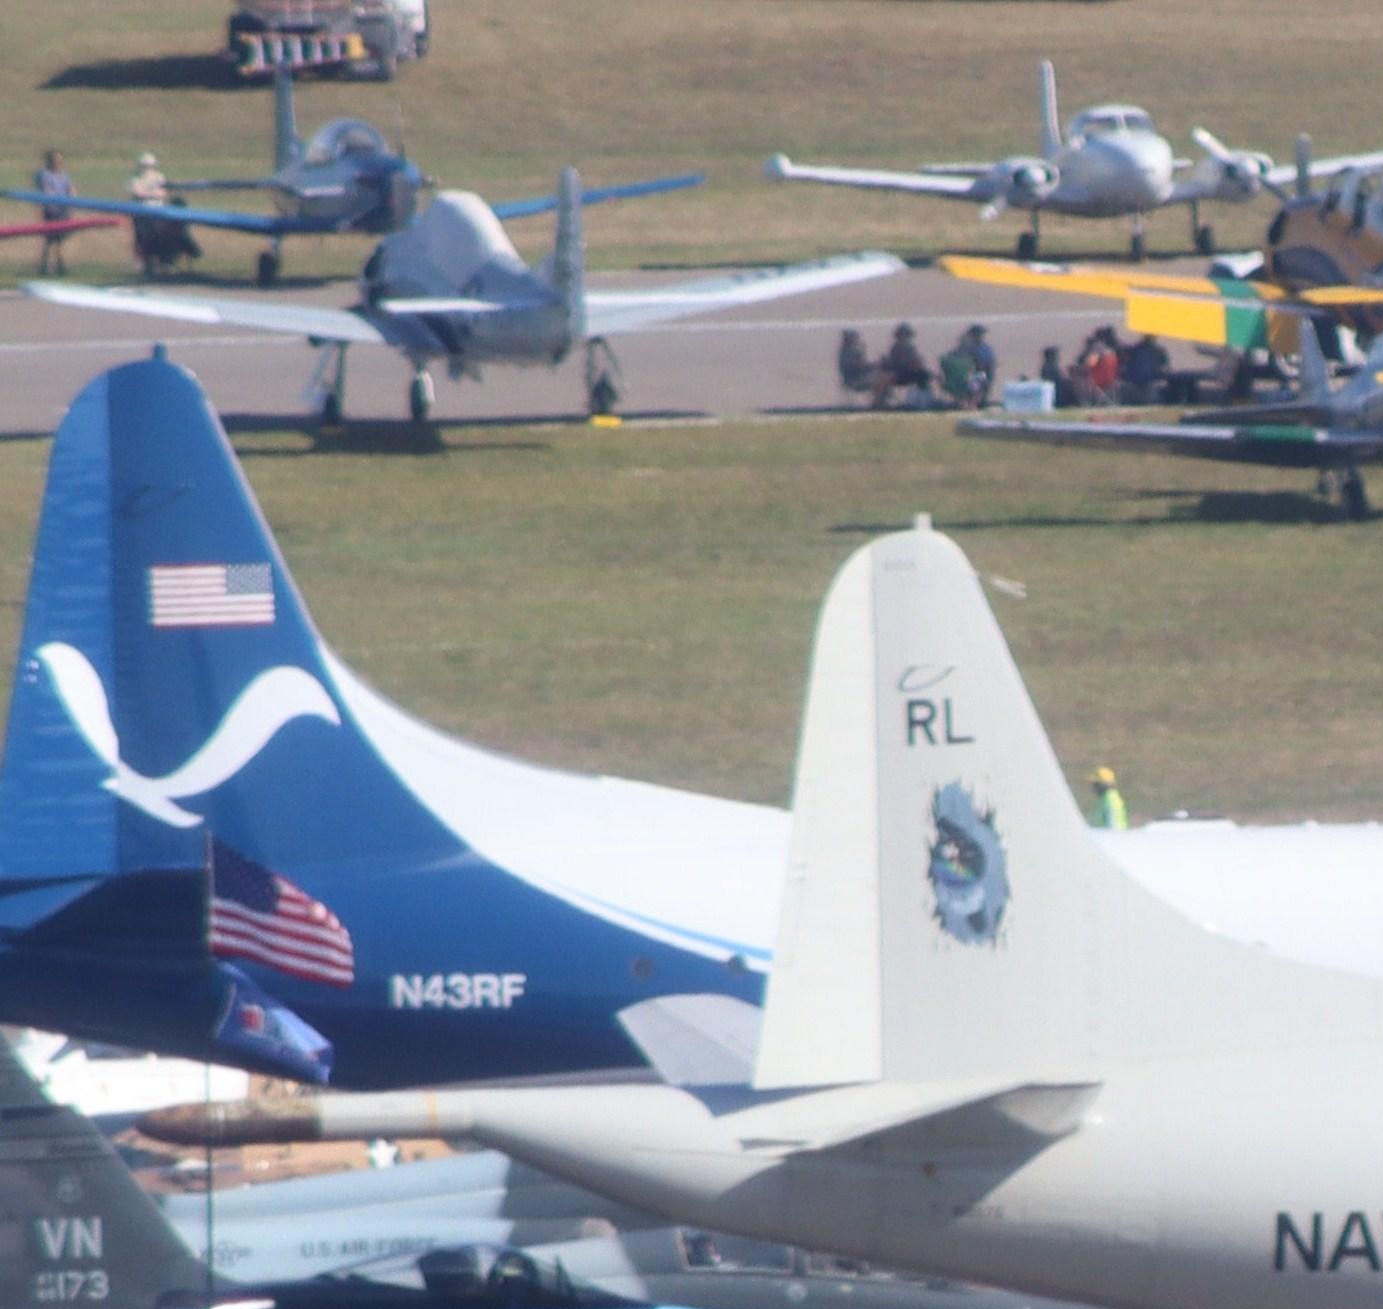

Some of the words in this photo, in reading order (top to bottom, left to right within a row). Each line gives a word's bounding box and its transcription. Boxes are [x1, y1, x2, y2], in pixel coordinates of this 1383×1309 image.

[906, 699, 976, 746] RL
[390, 972, 527, 1009] N43RF
[37, 1216, 103, 1260] VN
